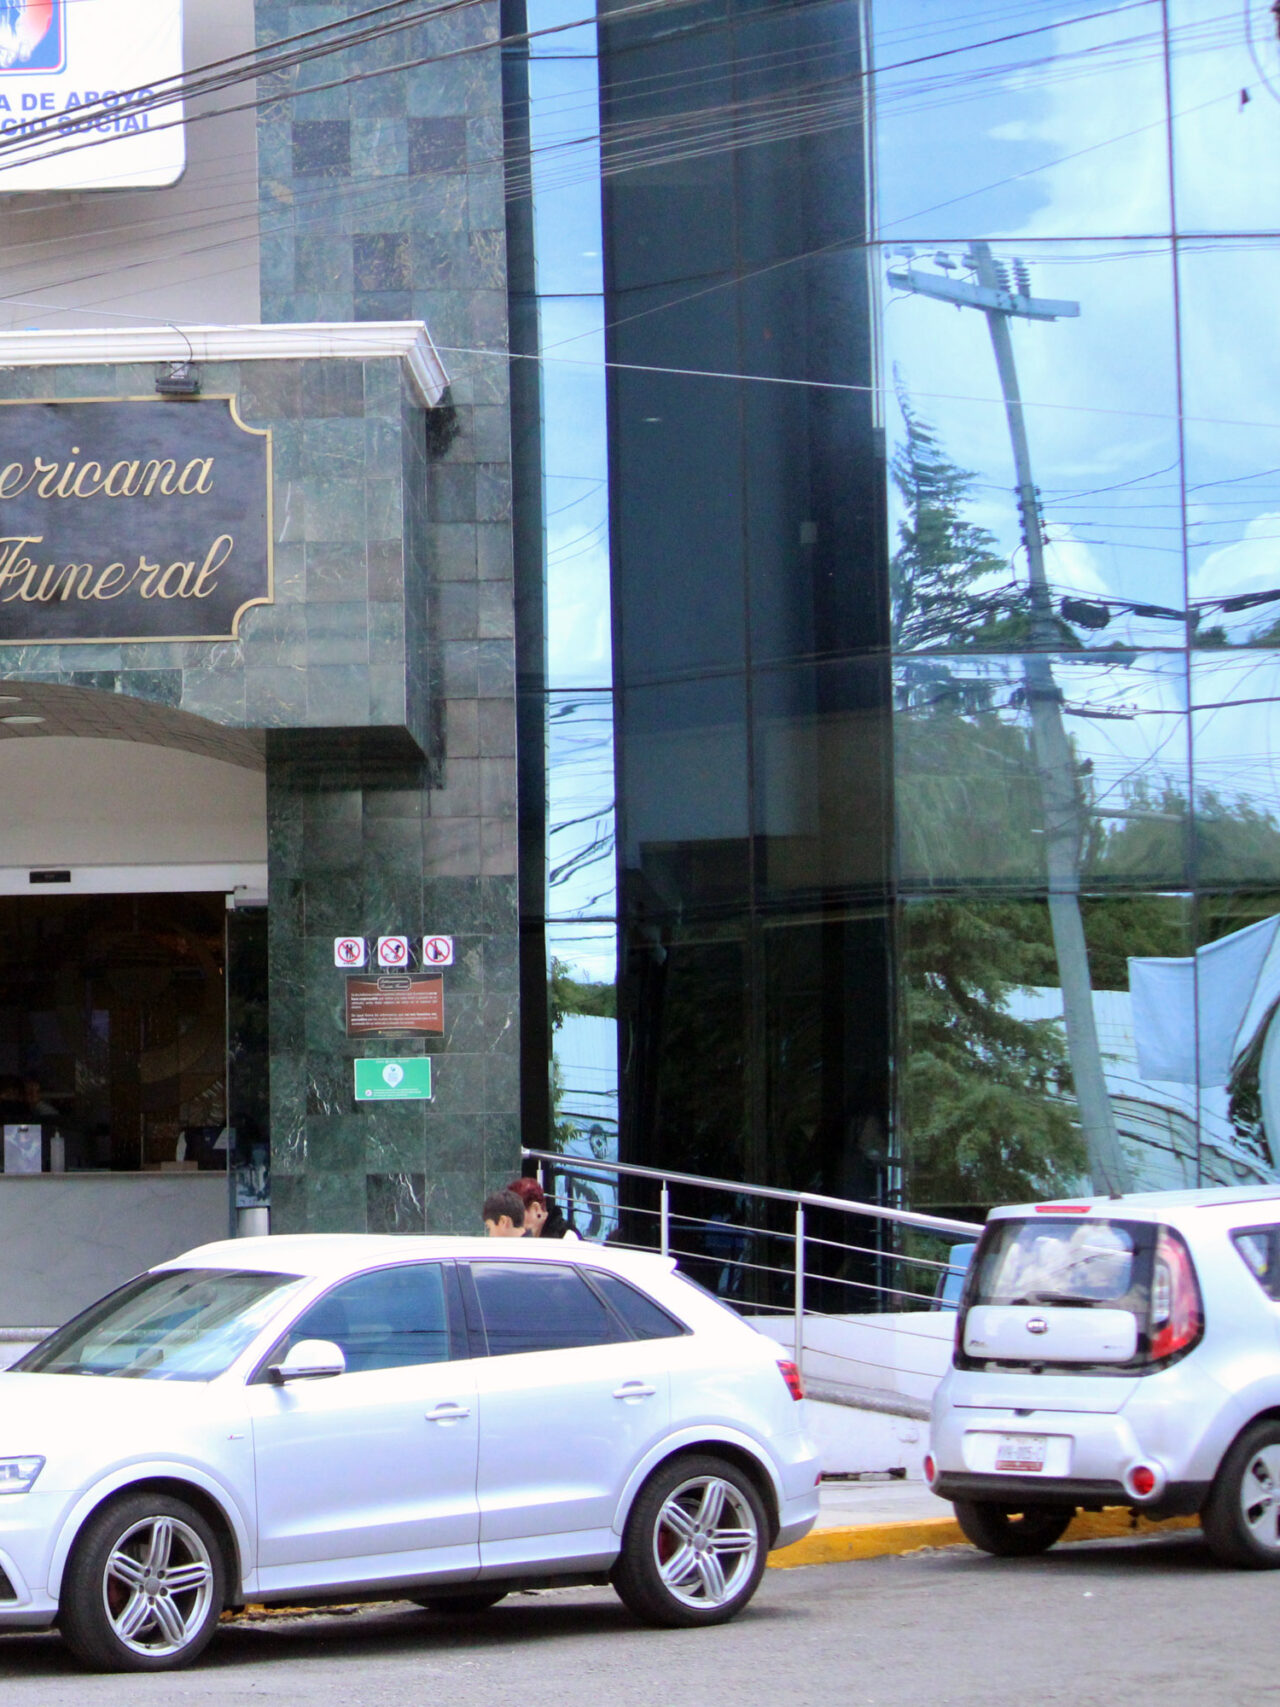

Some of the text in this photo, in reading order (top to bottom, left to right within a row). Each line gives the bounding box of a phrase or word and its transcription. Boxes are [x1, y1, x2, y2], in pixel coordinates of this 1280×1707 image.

[21, 92, 55, 112] DE
[65, 88, 155, 110] APOYO
[57, 114, 150, 136] SOCIAL
